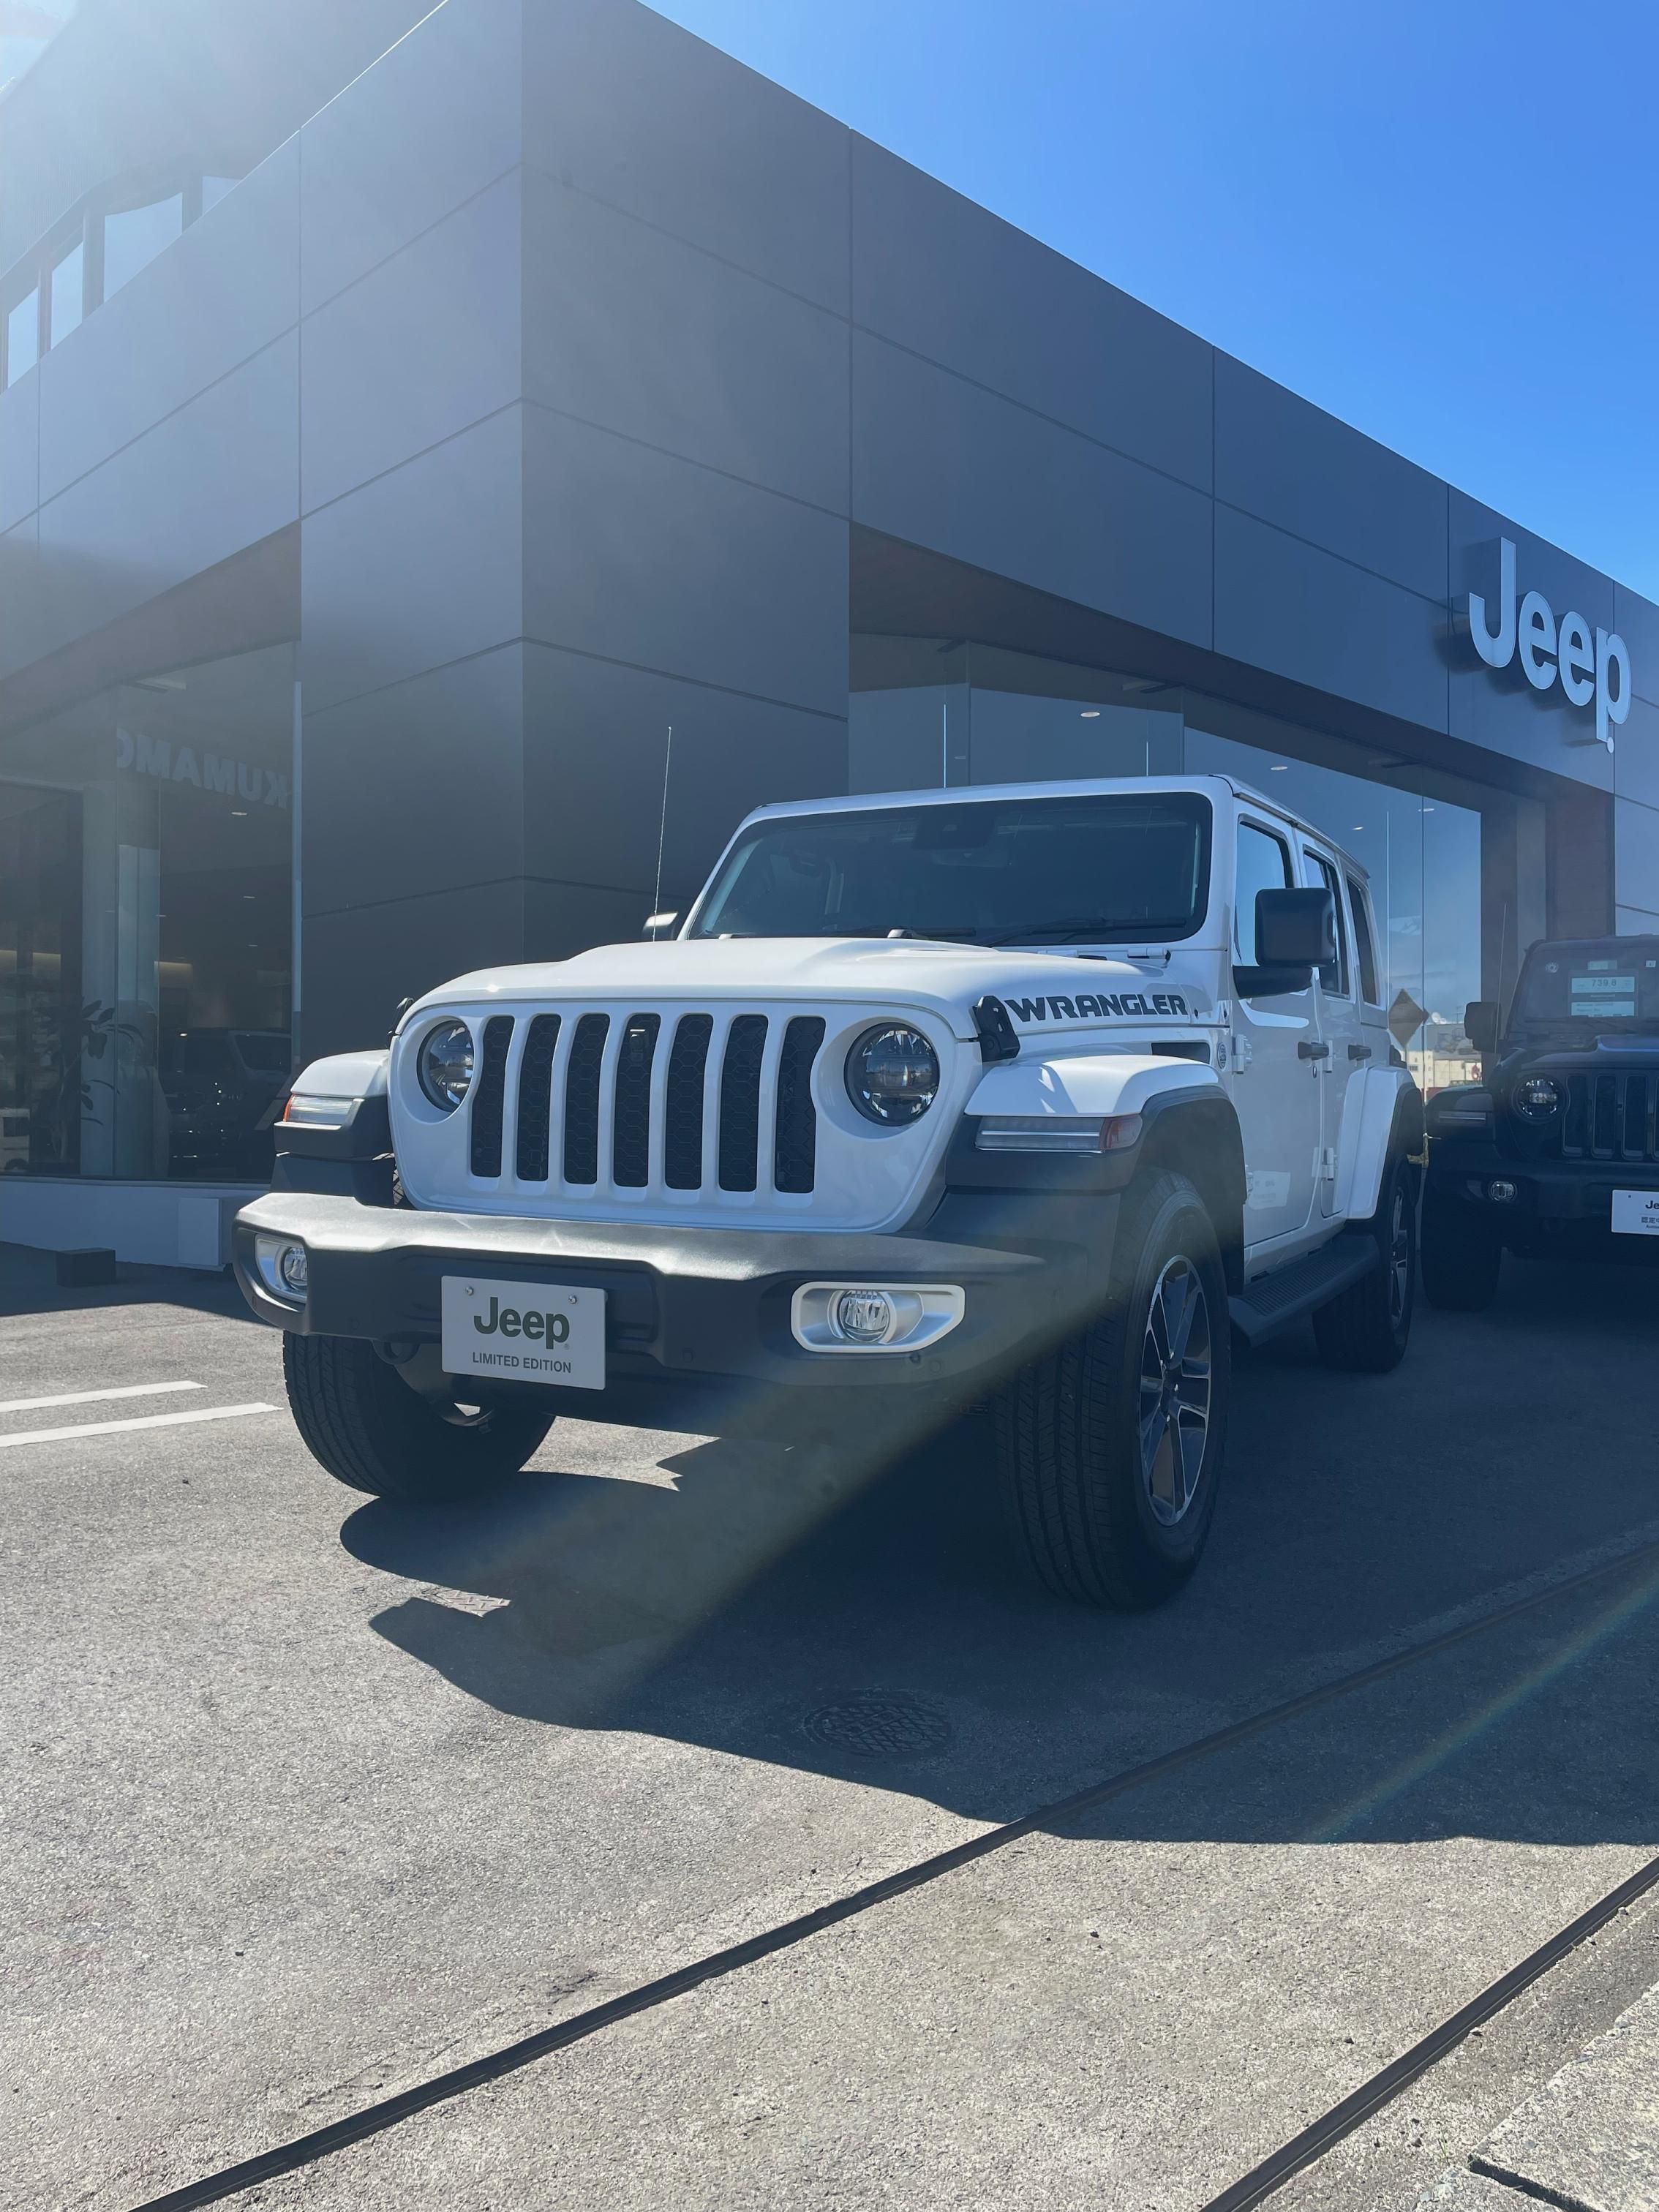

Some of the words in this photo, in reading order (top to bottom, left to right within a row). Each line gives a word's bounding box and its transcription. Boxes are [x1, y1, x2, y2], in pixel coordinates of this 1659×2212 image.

[1470, 537, 1631, 742] Jeep
[1004, 994, 1189, 1023] WRANGLER
[473, 1296, 570, 1350] Jeep
[473, 1352, 519, 1368] LIMITED
[523, 1358, 571, 1374] EDITION
